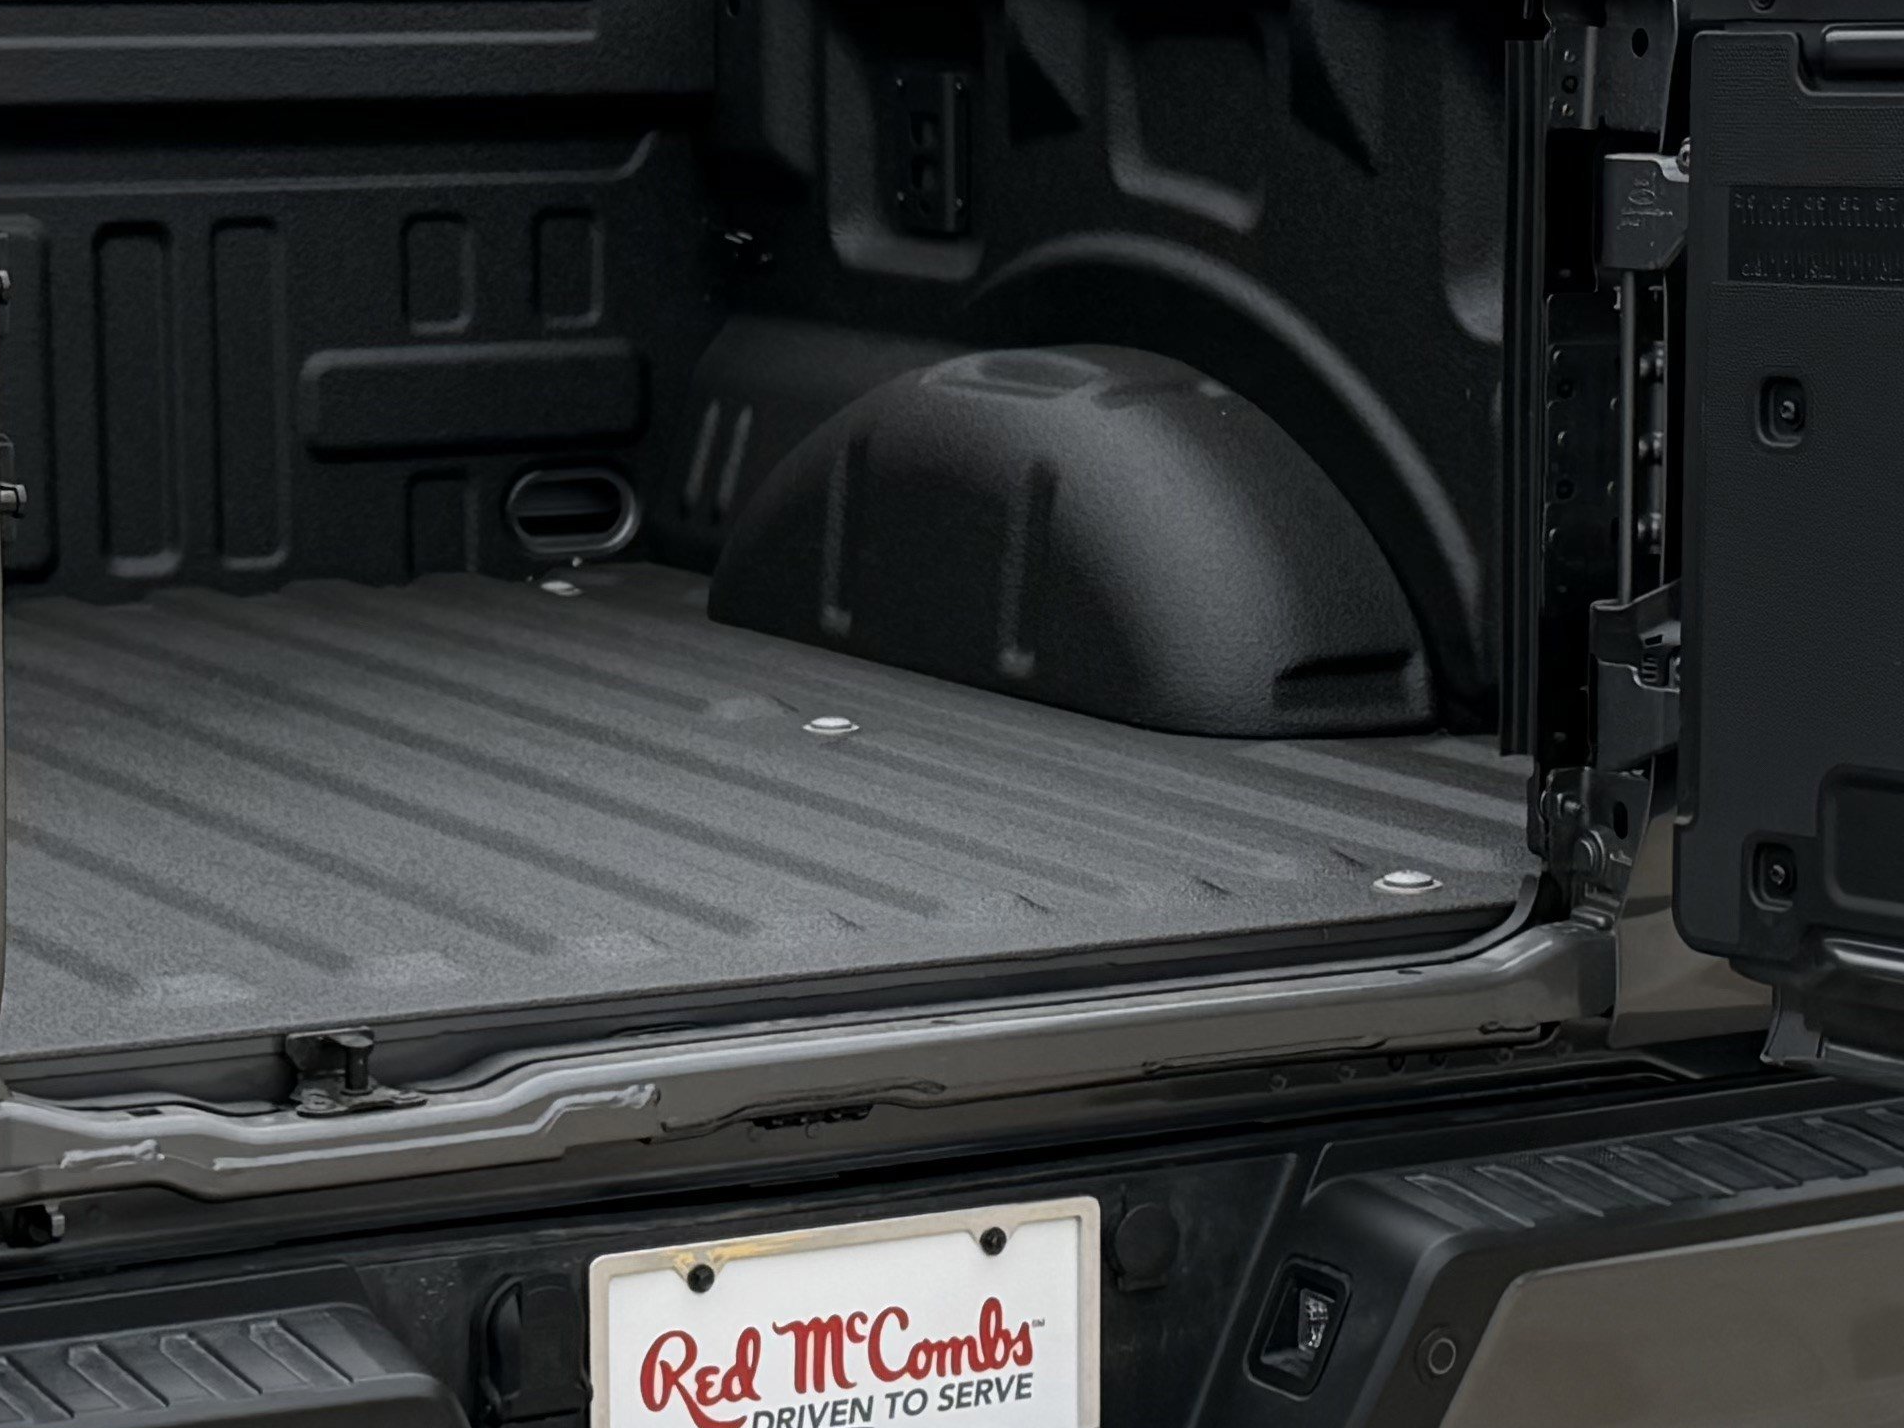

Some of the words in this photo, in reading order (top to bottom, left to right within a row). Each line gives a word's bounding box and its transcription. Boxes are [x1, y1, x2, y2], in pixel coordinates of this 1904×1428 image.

[772, 1296, 1034, 1395] McCombs
[883, 1387, 928, 1420] TO
[937, 1372, 1034, 1410] SERVE
